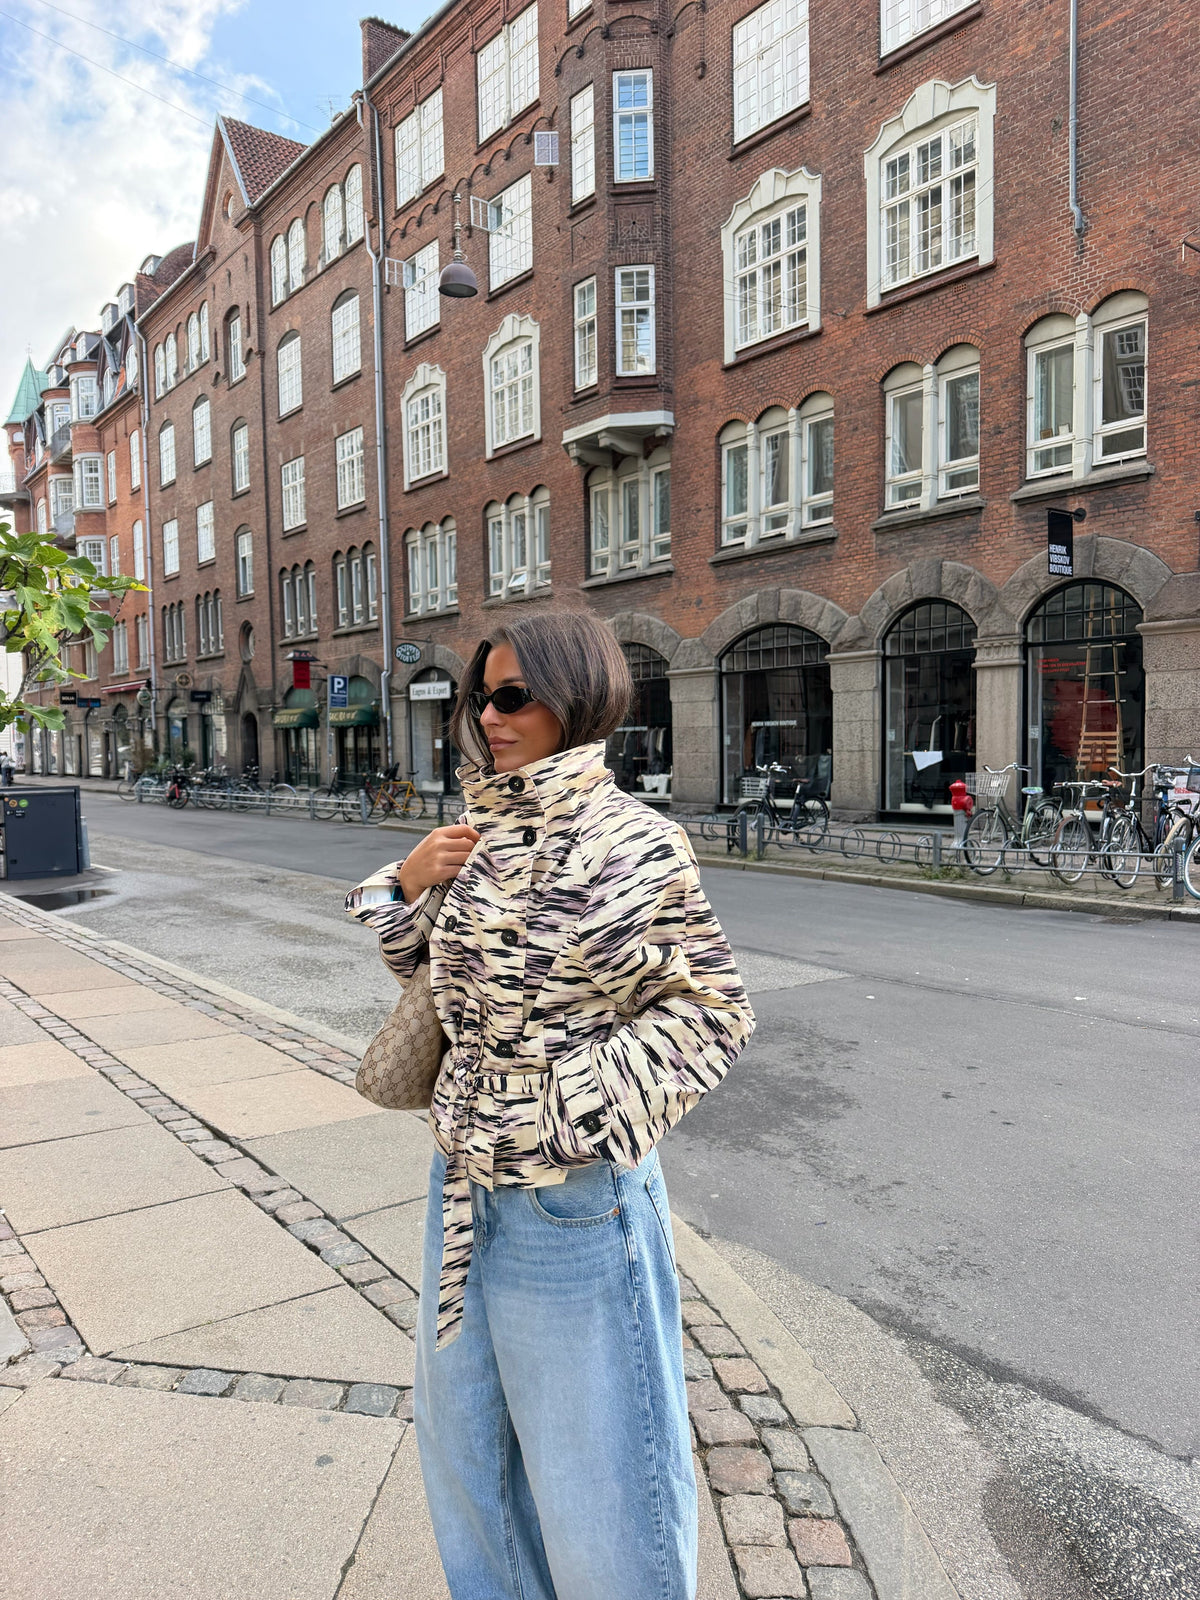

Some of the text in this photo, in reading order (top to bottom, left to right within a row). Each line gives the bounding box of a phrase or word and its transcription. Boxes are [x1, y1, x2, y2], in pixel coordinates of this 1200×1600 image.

[1049, 544, 1066, 554] HENRIK
[1049, 554, 1070, 564] VIBSKOV
[1050, 564, 1072, 575] BOUTIQUE
[333, 677, 344, 694] P
